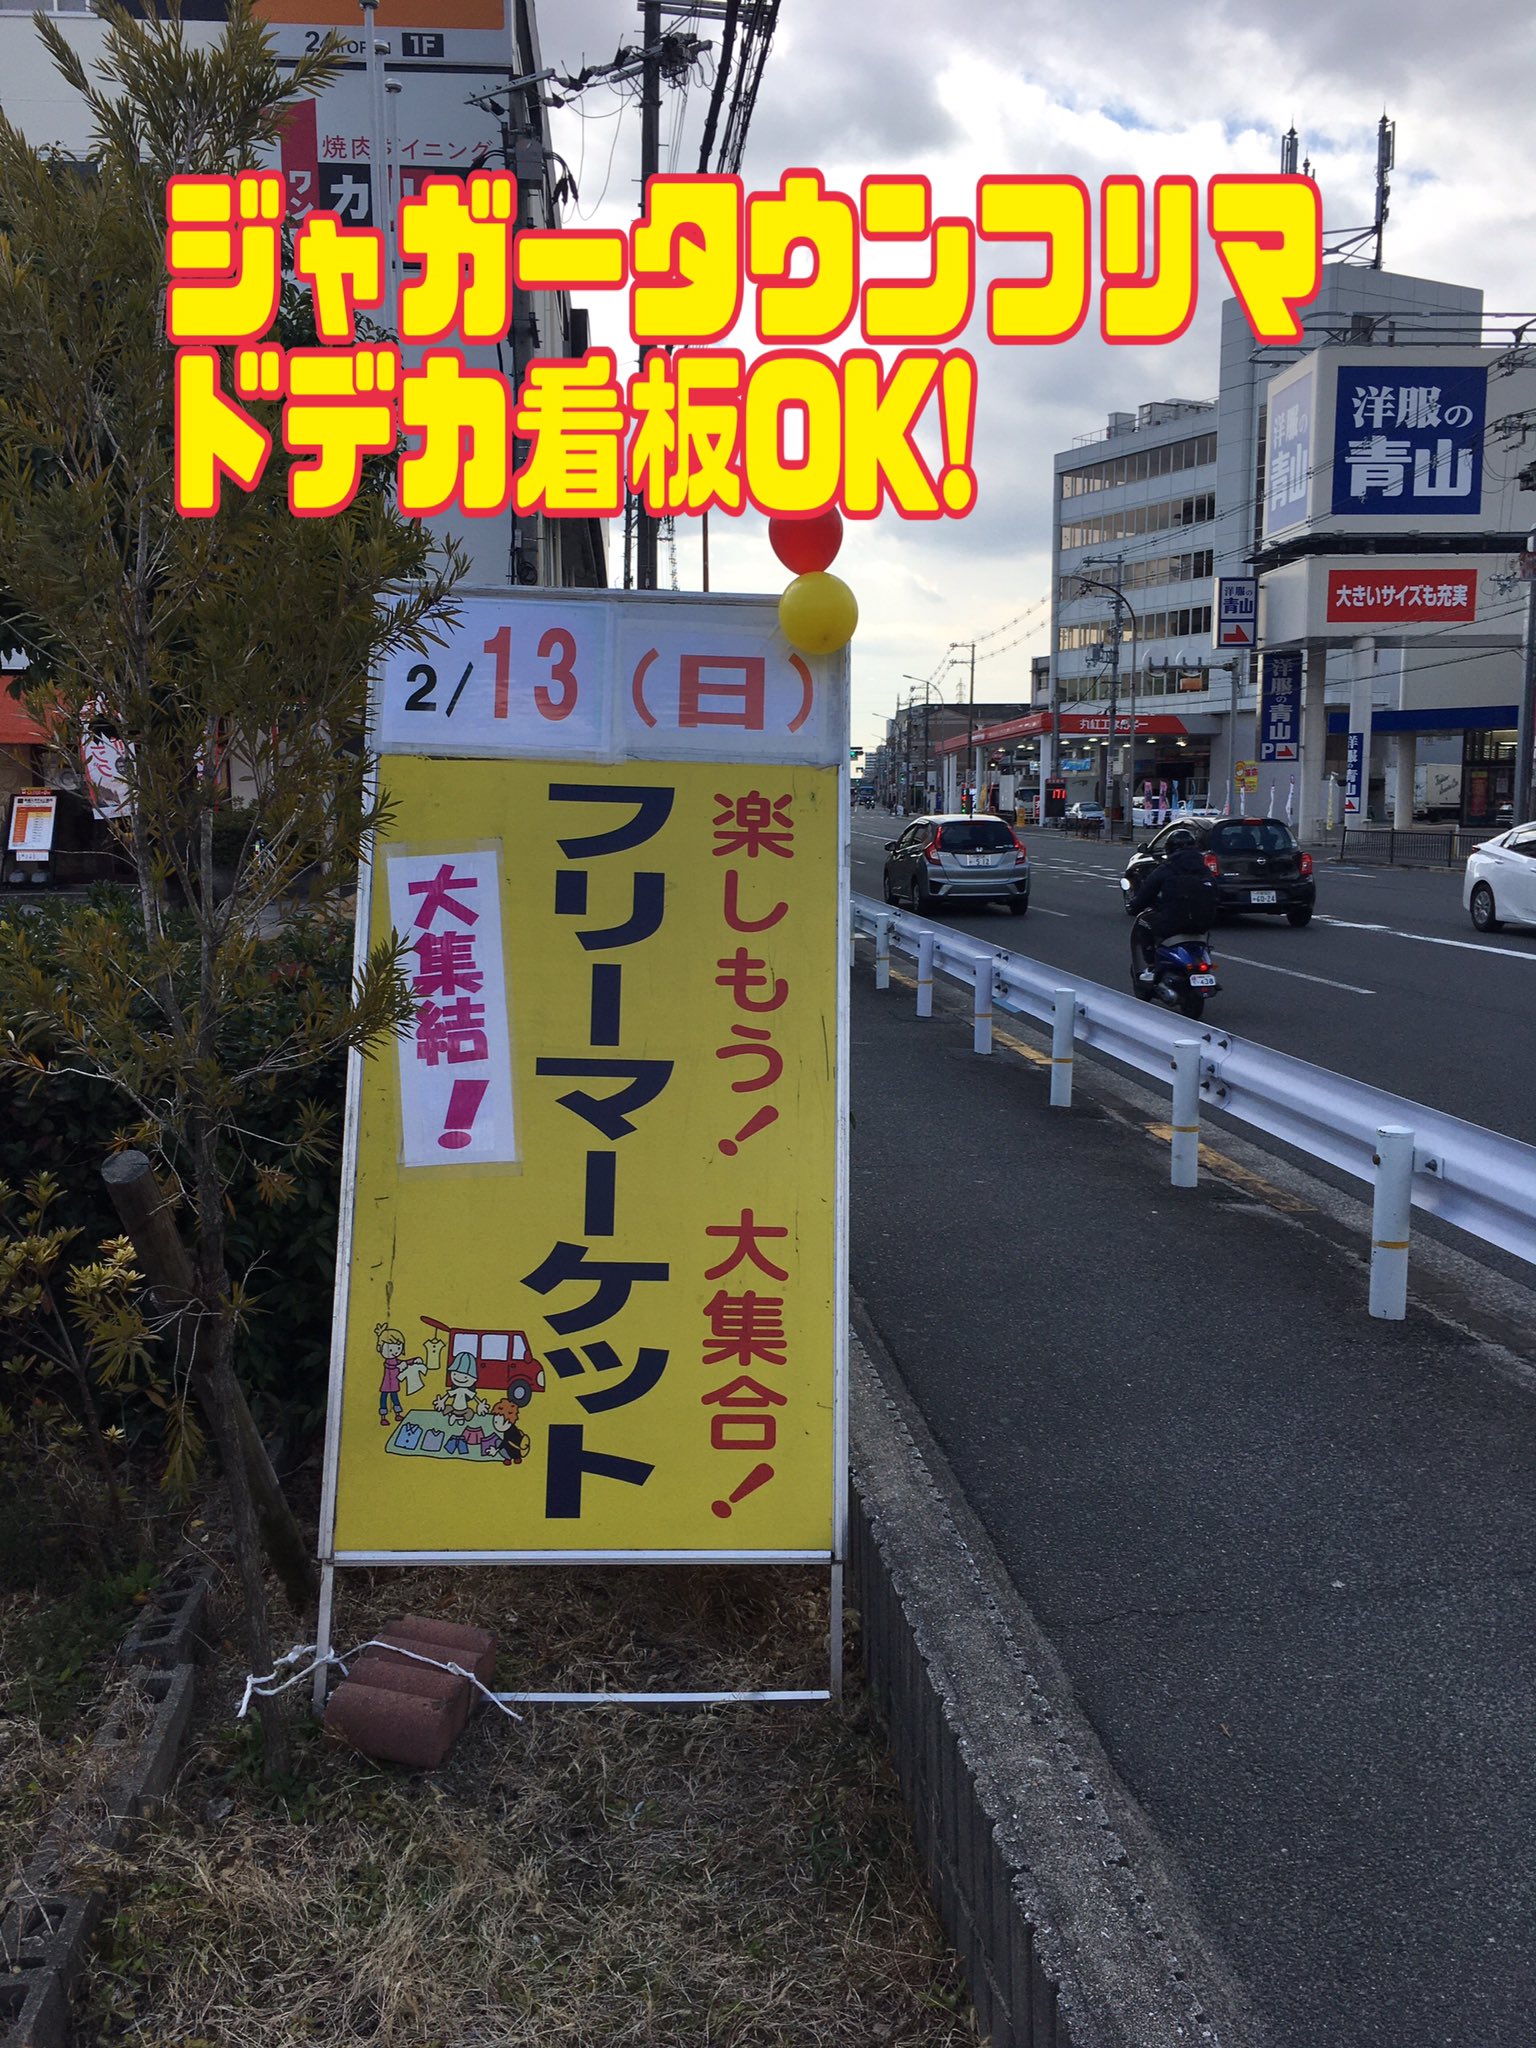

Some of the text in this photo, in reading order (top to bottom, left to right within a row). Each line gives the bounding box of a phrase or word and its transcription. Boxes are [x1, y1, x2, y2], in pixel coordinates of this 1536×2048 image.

[409, 35, 435, 55] 1F
[322, 134, 494, 162] 焼肉イニング
[1273, 404, 1308, 449] 洋服の
[1351, 385, 1474, 429] 洋服の
[1270, 442, 1308, 512] 青山
[1344, 434, 1474, 498] 青山
[1223, 598, 1254, 615] 青山
[1224, 586, 1253, 597] 洋服の
[1335, 584, 1469, 607] 大きいサイズも充実
[404, 625, 814, 734] 2/13 （日）
[1268, 657, 1294, 741] 洋服の青山
[1261, 743, 1275, 760] P
[407, 863, 491, 1150] 大集結！
[520, 783, 676, 1520] フリーマーケット
[701, 790, 795, 1519] 楽しもう！ 大集合！
